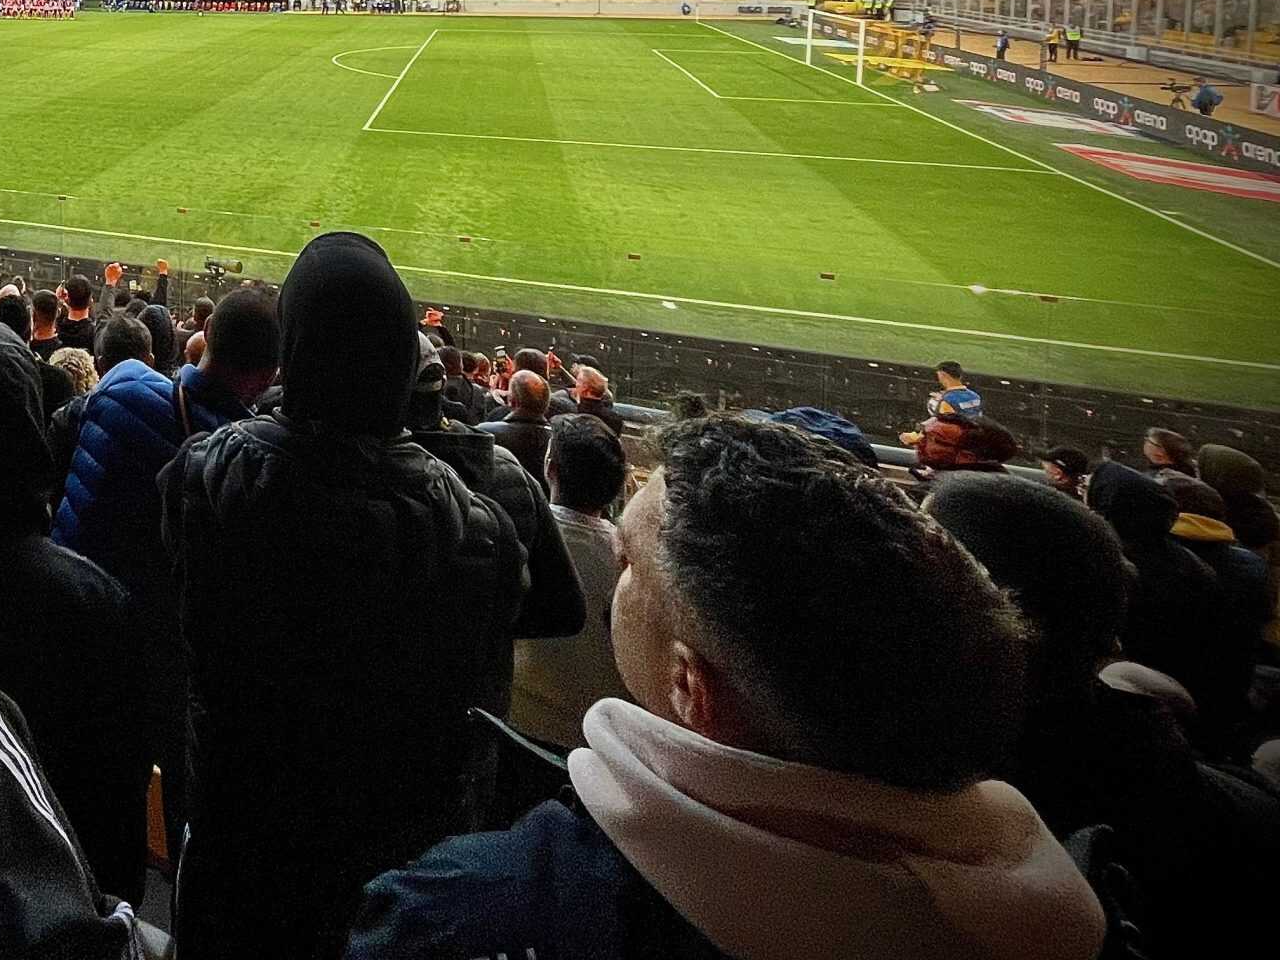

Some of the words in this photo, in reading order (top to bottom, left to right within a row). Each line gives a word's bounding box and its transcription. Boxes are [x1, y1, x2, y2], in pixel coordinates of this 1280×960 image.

[970, 61, 987, 77] opap
[996, 68, 1016, 82] arena
[1025, 77, 1045, 94] opap
[1056, 86, 1081, 103] arena
[1093, 98, 1118, 118] opap
[1134, 109, 1167, 130] arena
[1185, 125, 1218, 150] opap
[1242, 141, 1280, 167] arena
